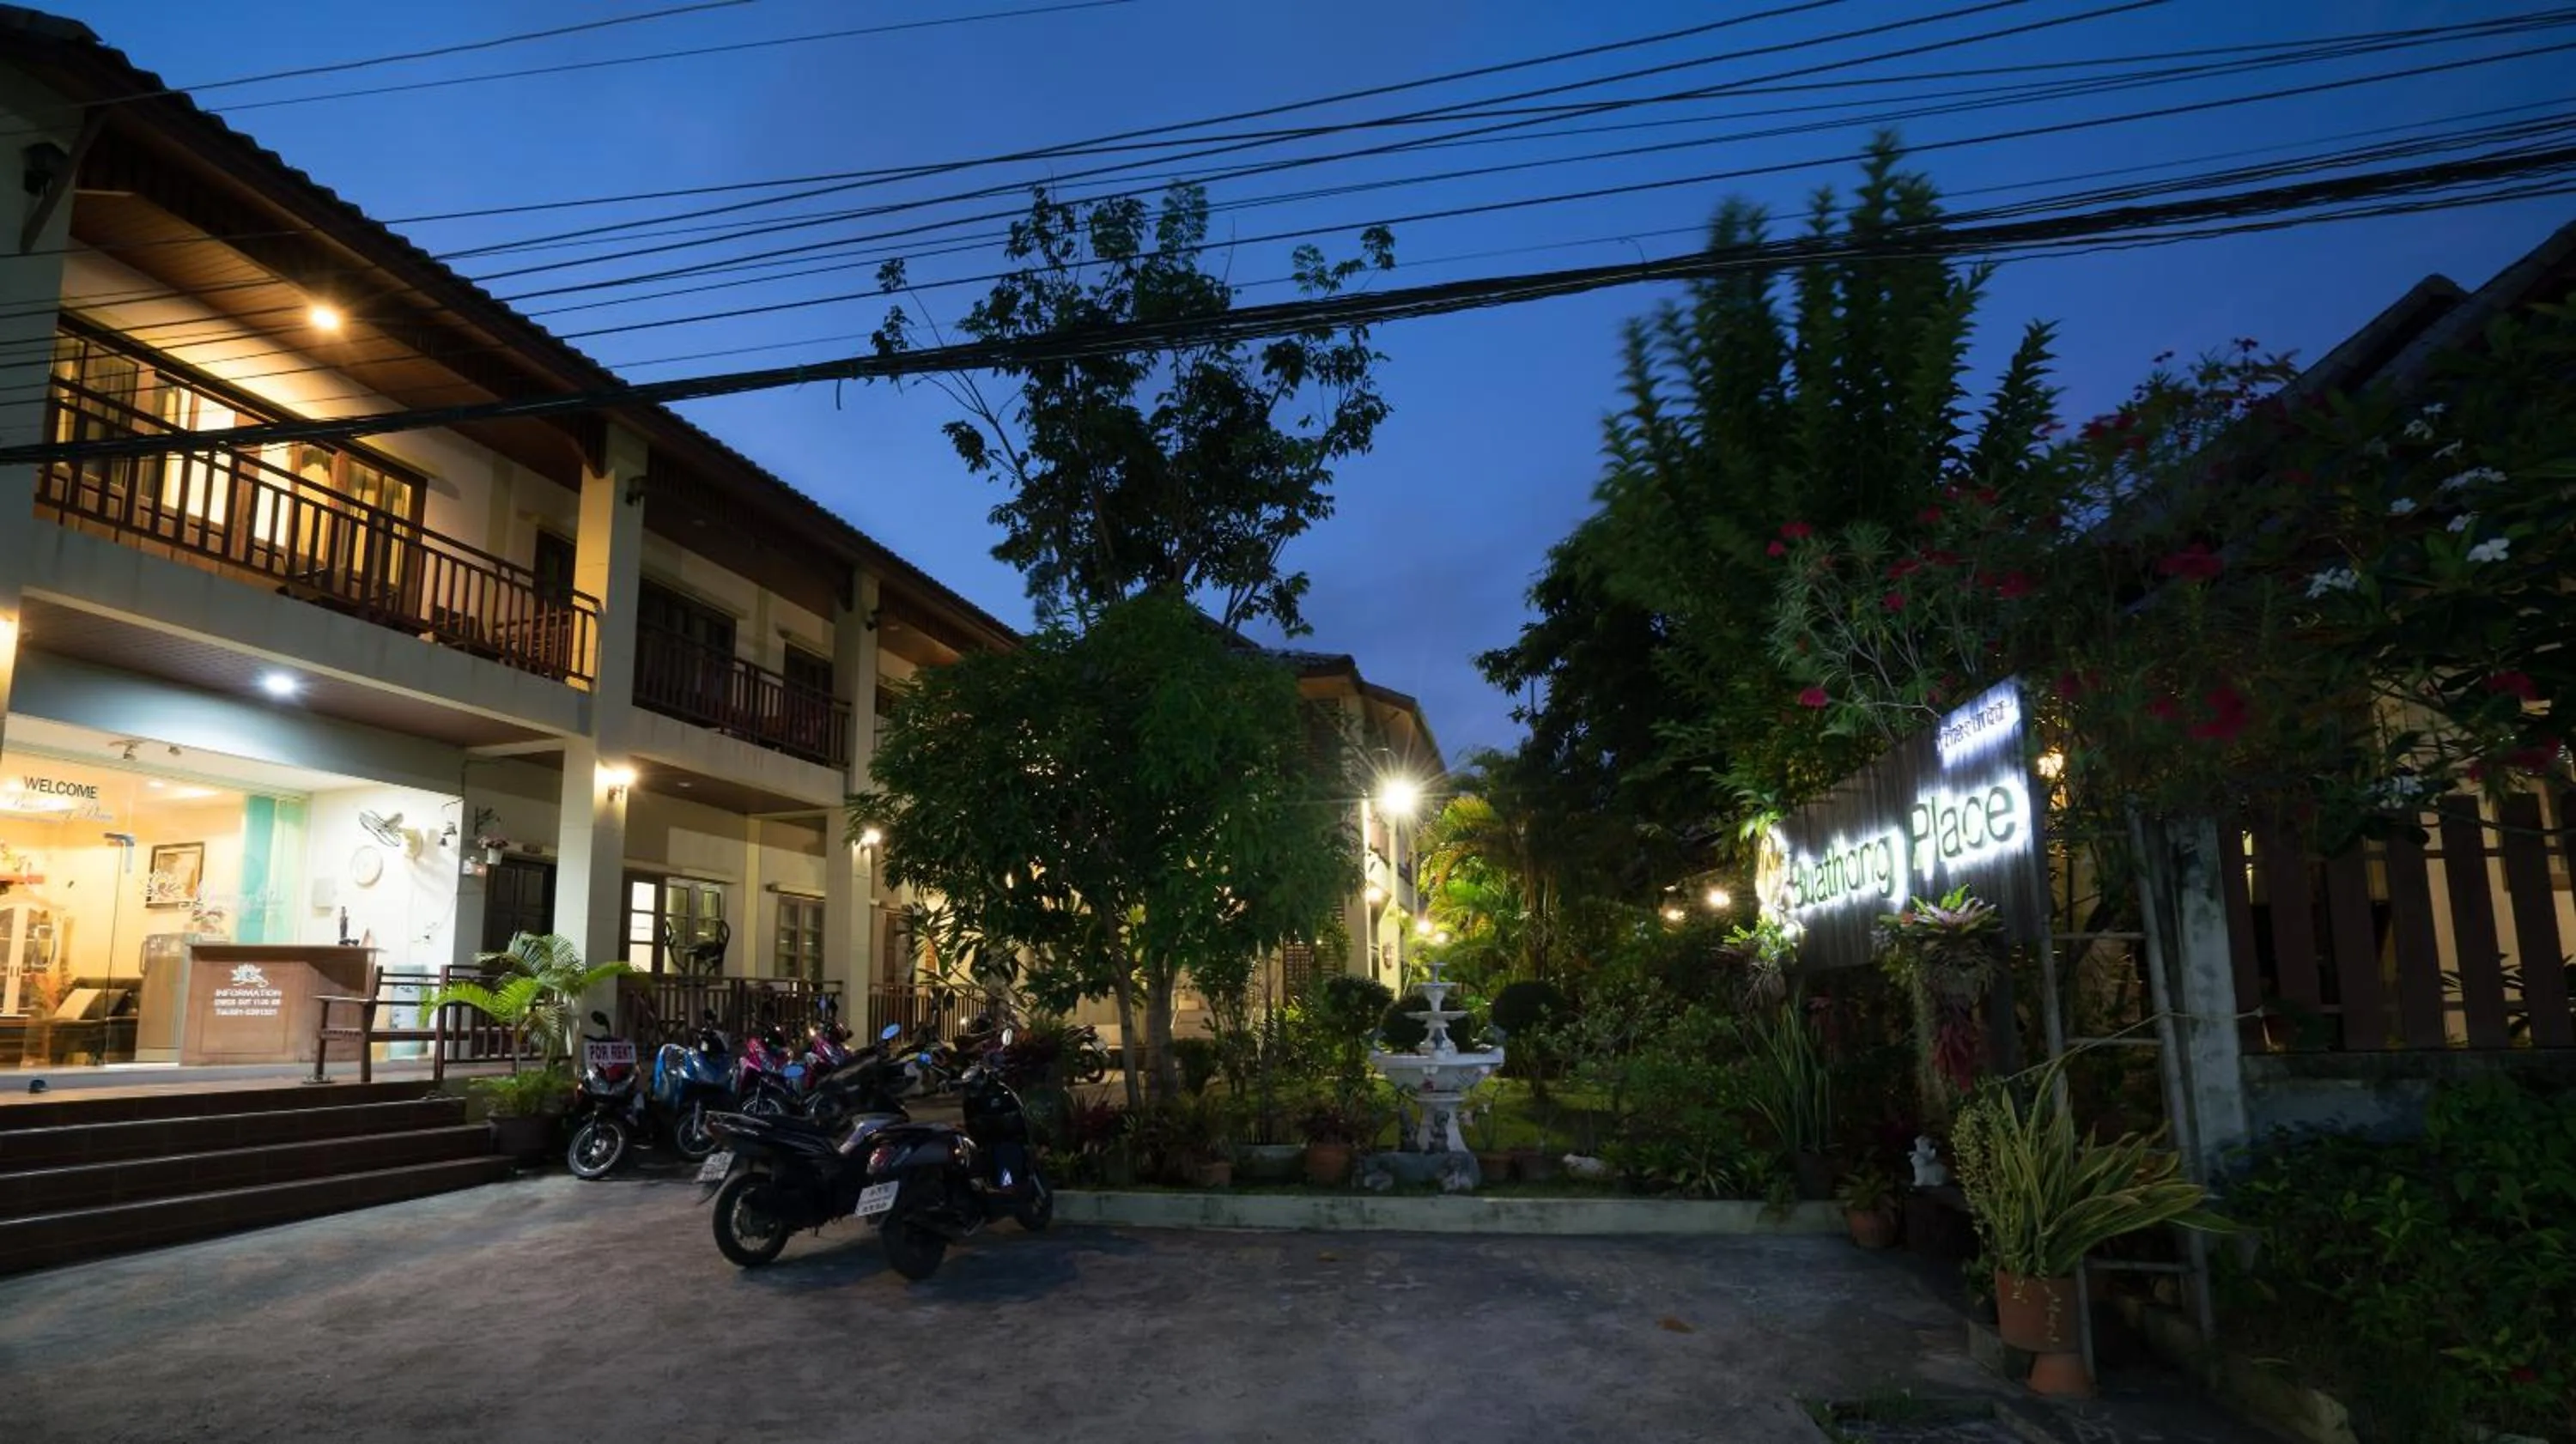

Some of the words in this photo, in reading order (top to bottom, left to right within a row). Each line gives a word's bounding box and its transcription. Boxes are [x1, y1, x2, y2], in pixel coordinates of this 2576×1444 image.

[24, 776, 98, 799] WELCOME
[1906, 786, 2016, 870] Place
[590, 1044, 609, 1059] FOR
[611, 1044, 634, 1059] RENT
